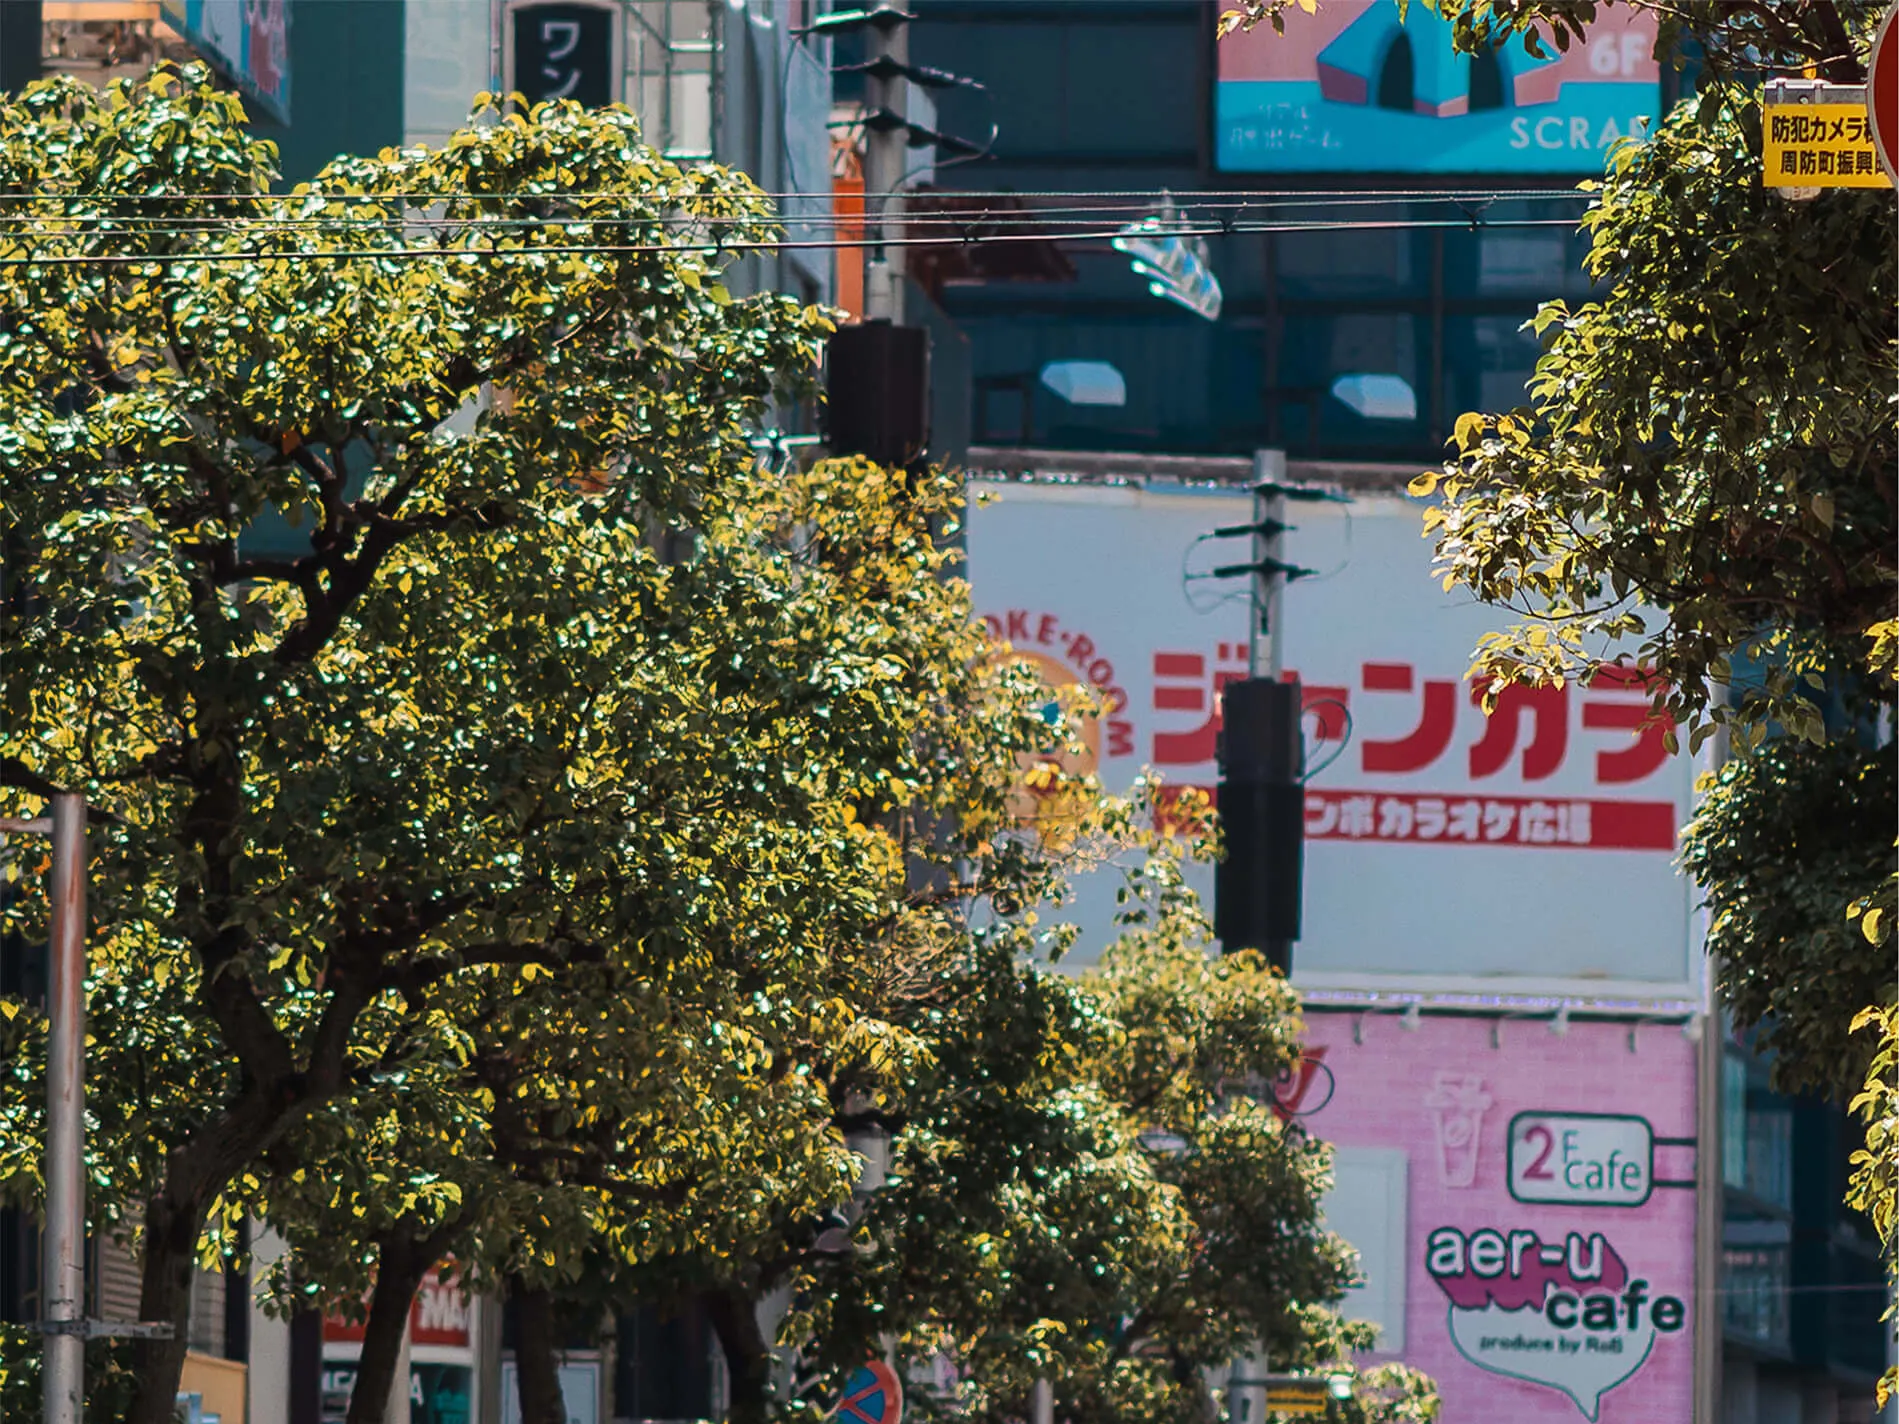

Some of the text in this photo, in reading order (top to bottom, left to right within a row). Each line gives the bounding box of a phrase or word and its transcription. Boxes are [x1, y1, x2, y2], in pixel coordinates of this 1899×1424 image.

[1591, 33, 1647, 76] 6F
[1428, 1227, 1606, 1282] aer-u
[1545, 1279, 1686, 1332] cafe
